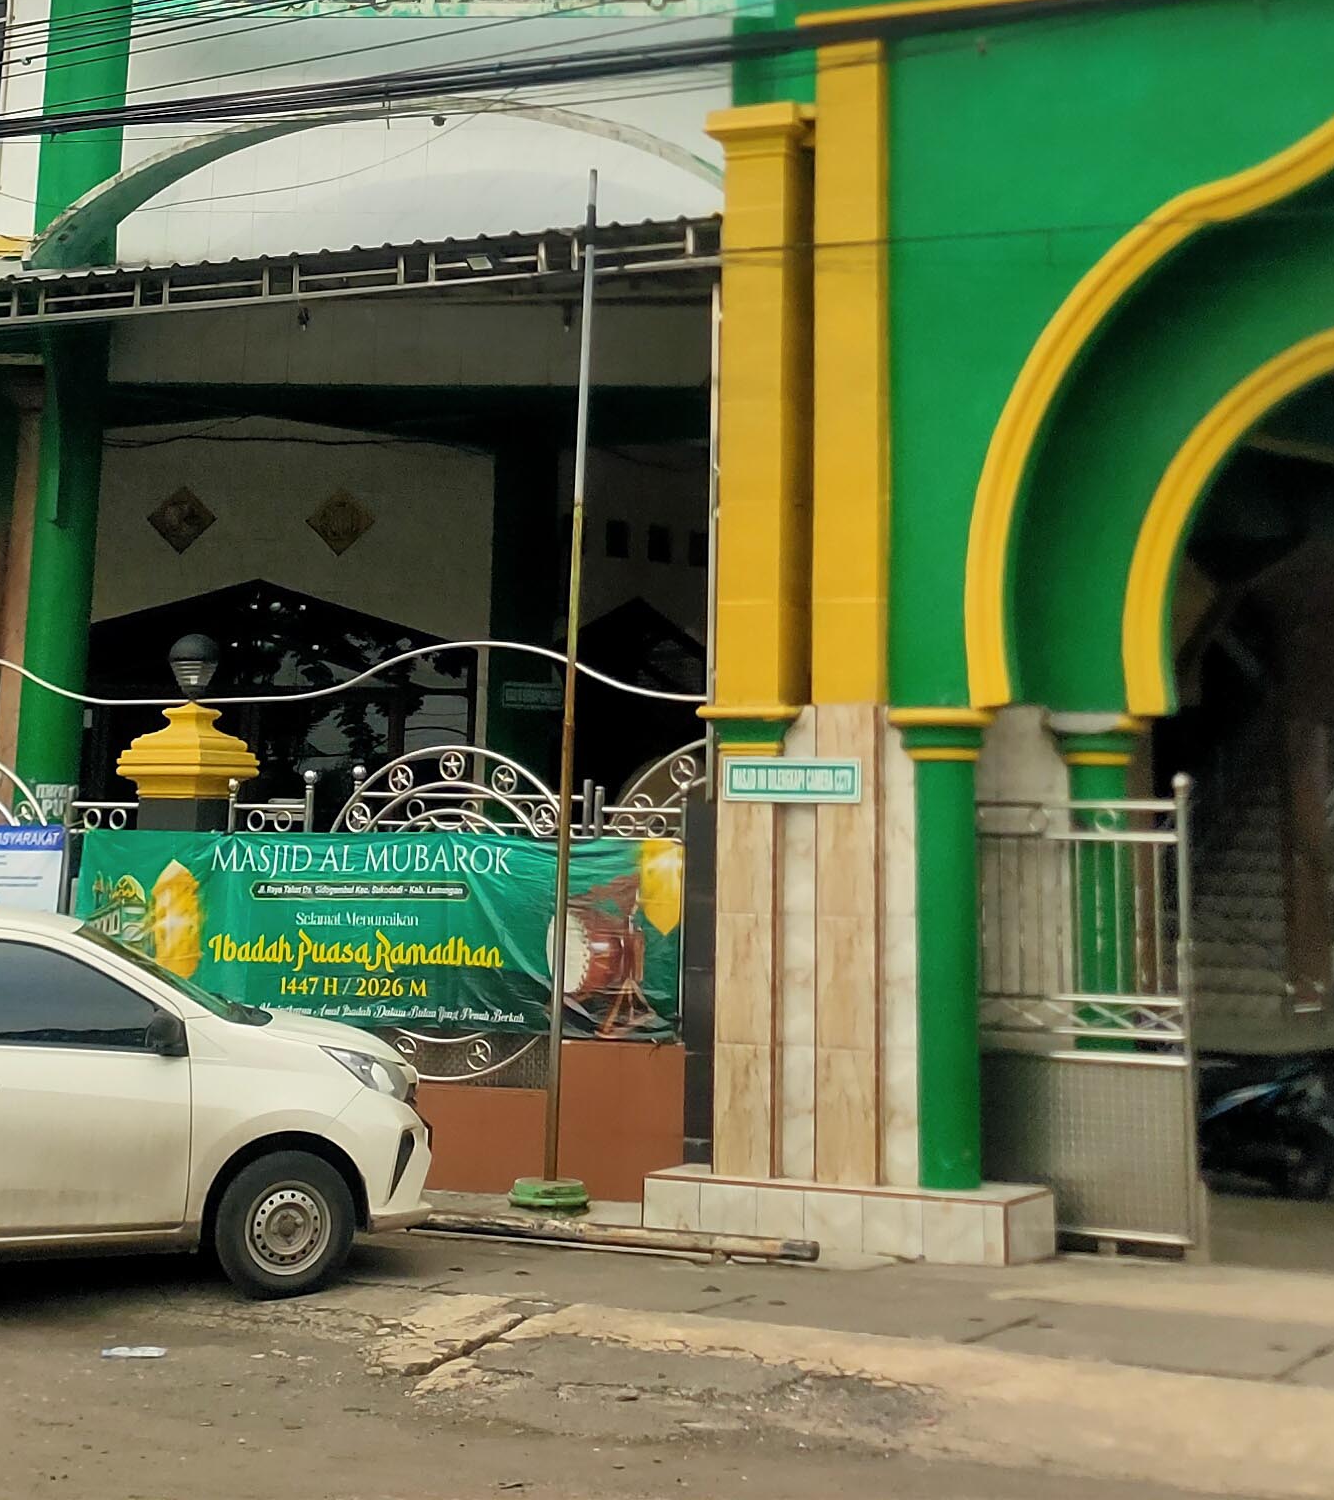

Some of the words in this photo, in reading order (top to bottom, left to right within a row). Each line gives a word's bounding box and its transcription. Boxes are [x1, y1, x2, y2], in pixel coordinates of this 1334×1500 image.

[211, 844, 313, 879] MASJID
[318, 844, 355, 873] AL
[363, 844, 512, 876] MUBAROK
[295, 911, 342, 926] Selamat
[346, 911, 419, 927] Menunaikan
[208, 933, 295, 964] Ibadah
[292, 928, 373, 972] Puasa
[364, 928, 504, 974] Ramadhan
[280, 976, 320, 996] 1447
[323, 977, 339, 996] H
[341, 978, 352, 996] /
[354, 977, 404, 997] 2026
[408, 979, 427, 997] M
